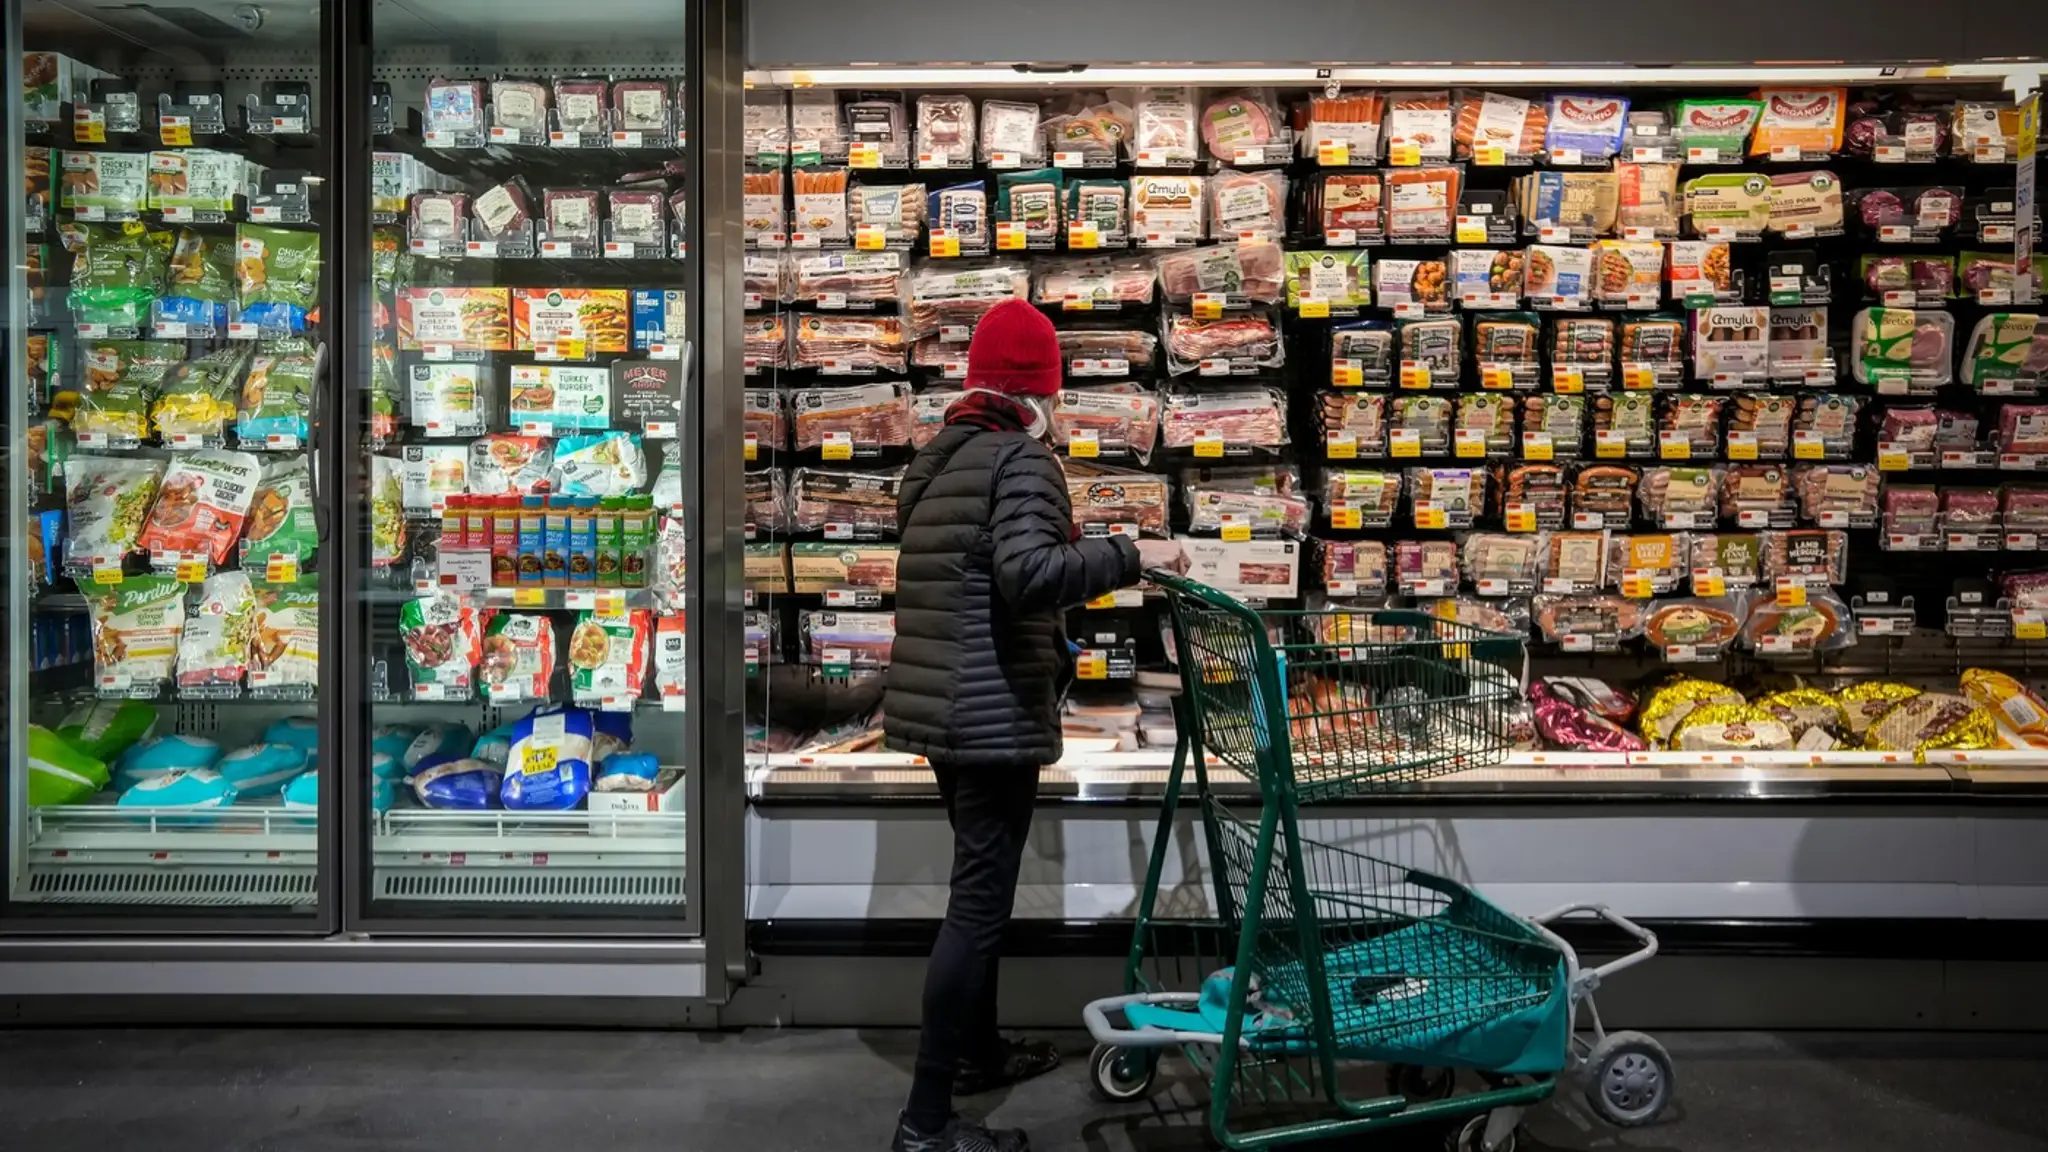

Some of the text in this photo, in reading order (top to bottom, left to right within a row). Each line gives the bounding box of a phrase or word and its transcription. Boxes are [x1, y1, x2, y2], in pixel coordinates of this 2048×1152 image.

[100, 160, 133, 168] CHICKEN
[100, 168, 128, 176] STRIPS
[622, 366, 668, 381] MEYER
[558, 375, 588, 383] TURKEY
[558, 383, 593, 392] BURGERS
[1795, 540, 1819, 549] LAMB
